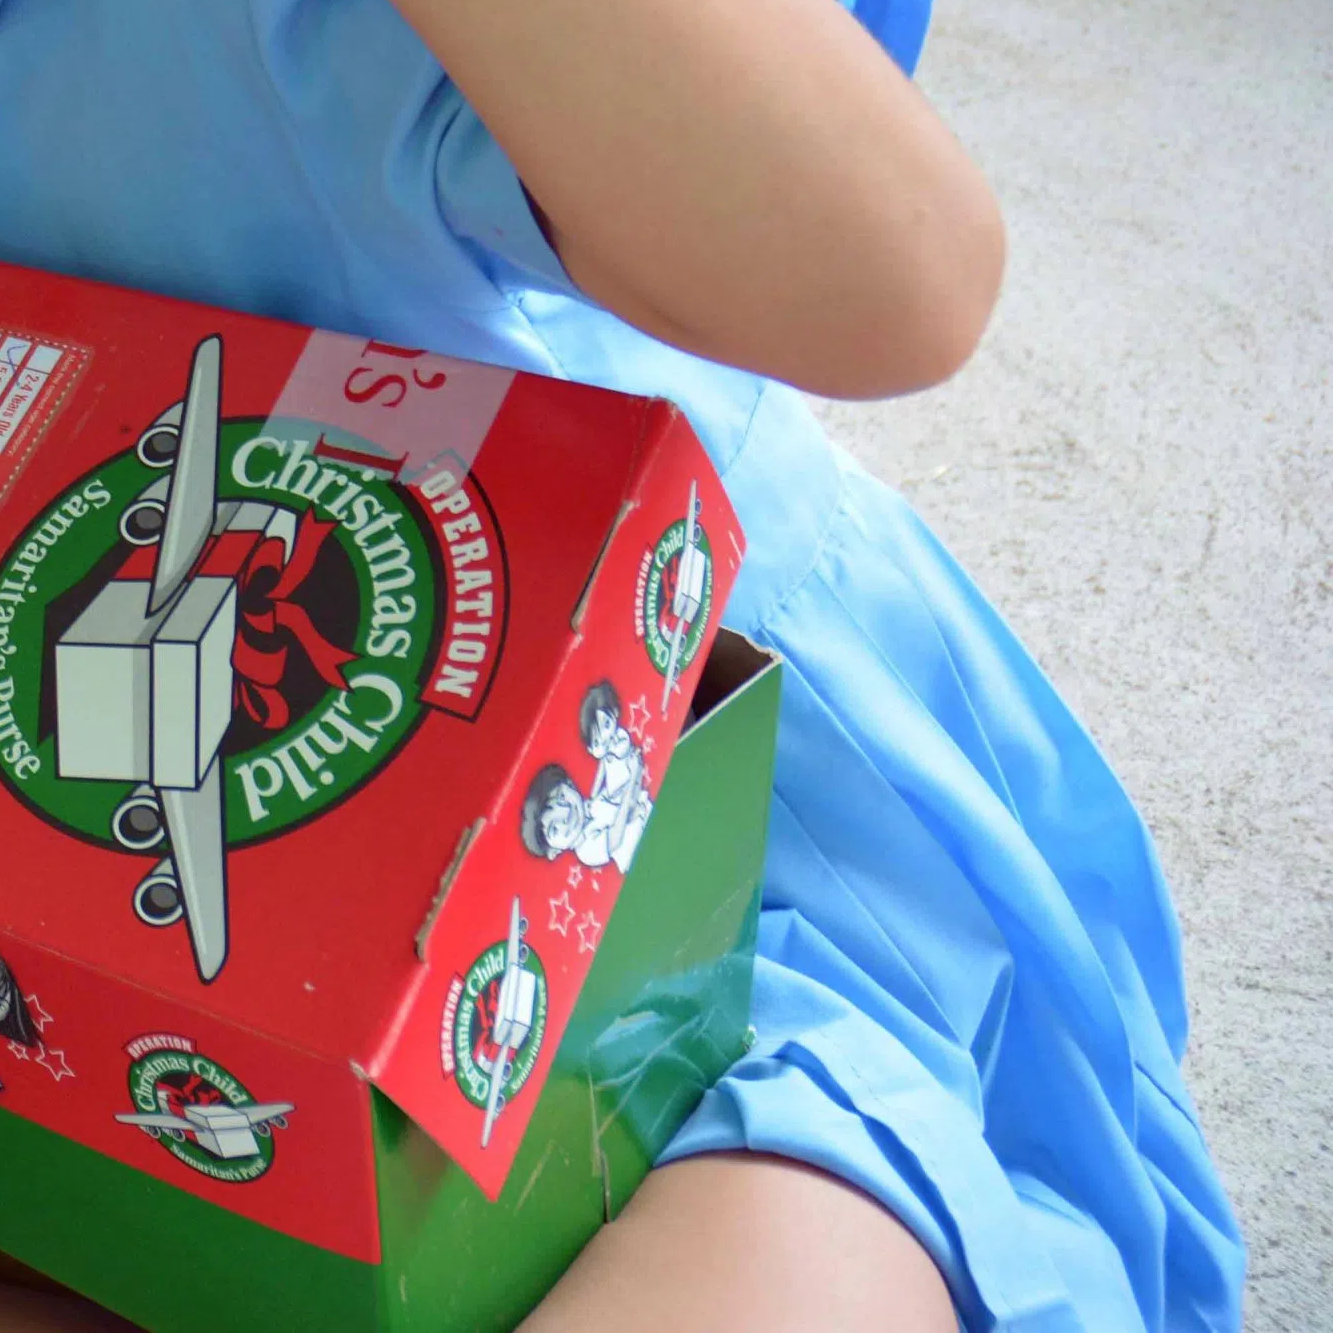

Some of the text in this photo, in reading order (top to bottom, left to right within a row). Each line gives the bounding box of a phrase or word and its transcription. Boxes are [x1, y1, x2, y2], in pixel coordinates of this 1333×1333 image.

[3, 391, 28, 418] Years
[20, 374, 39, 391] 2-4
[232, 436, 416, 659] Christmas
[420, 468, 493, 698] OPERATION
[236, 672, 403, 822] Child
[466, 948, 505, 997] Child
[126, 1034, 193, 1060] OPERATION
[135, 1056, 248, 1111] Christmas Child
